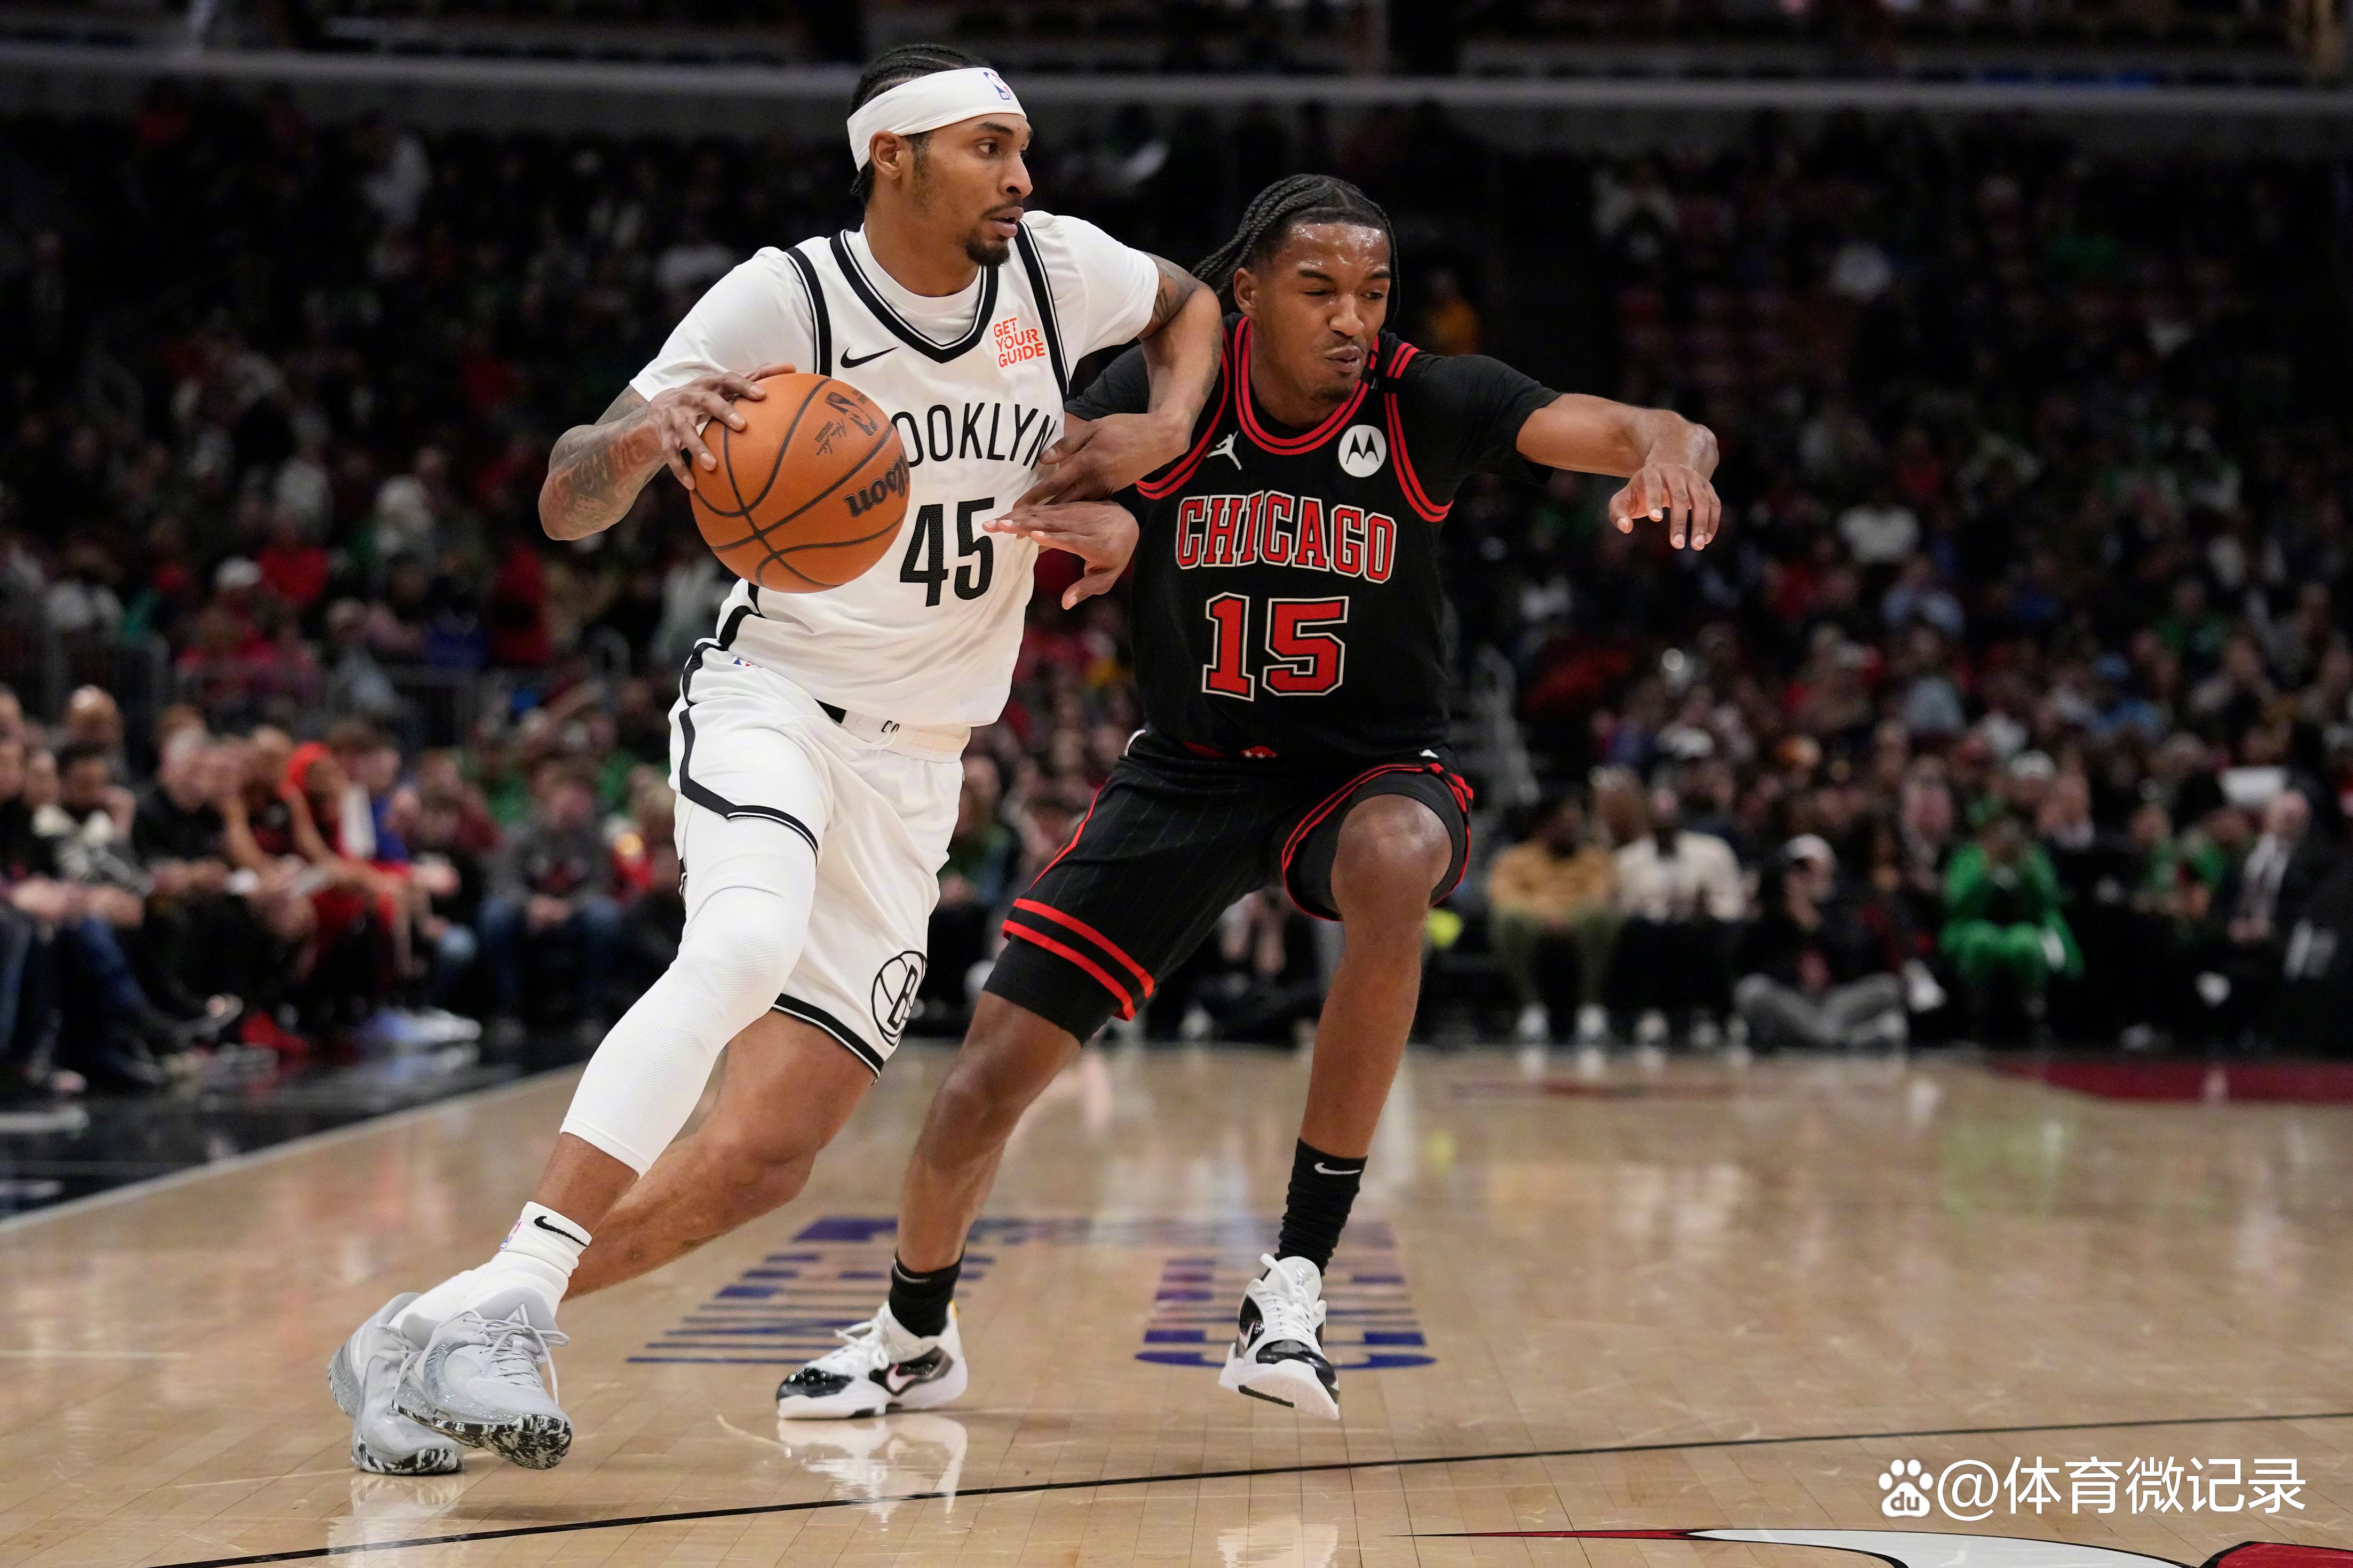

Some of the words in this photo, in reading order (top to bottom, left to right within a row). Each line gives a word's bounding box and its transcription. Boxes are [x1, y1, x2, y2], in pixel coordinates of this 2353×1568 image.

[994, 317, 1017, 338] GET
[996, 329, 1040, 352] YOUR
[999, 343, 1045, 368] GUIDE
[891, 402, 1056, 470] OOKLYN
[900, 497, 995, 607] 45
[1176, 490, 1397, 584] CHICAGO
[1202, 592, 1349, 702] 15
